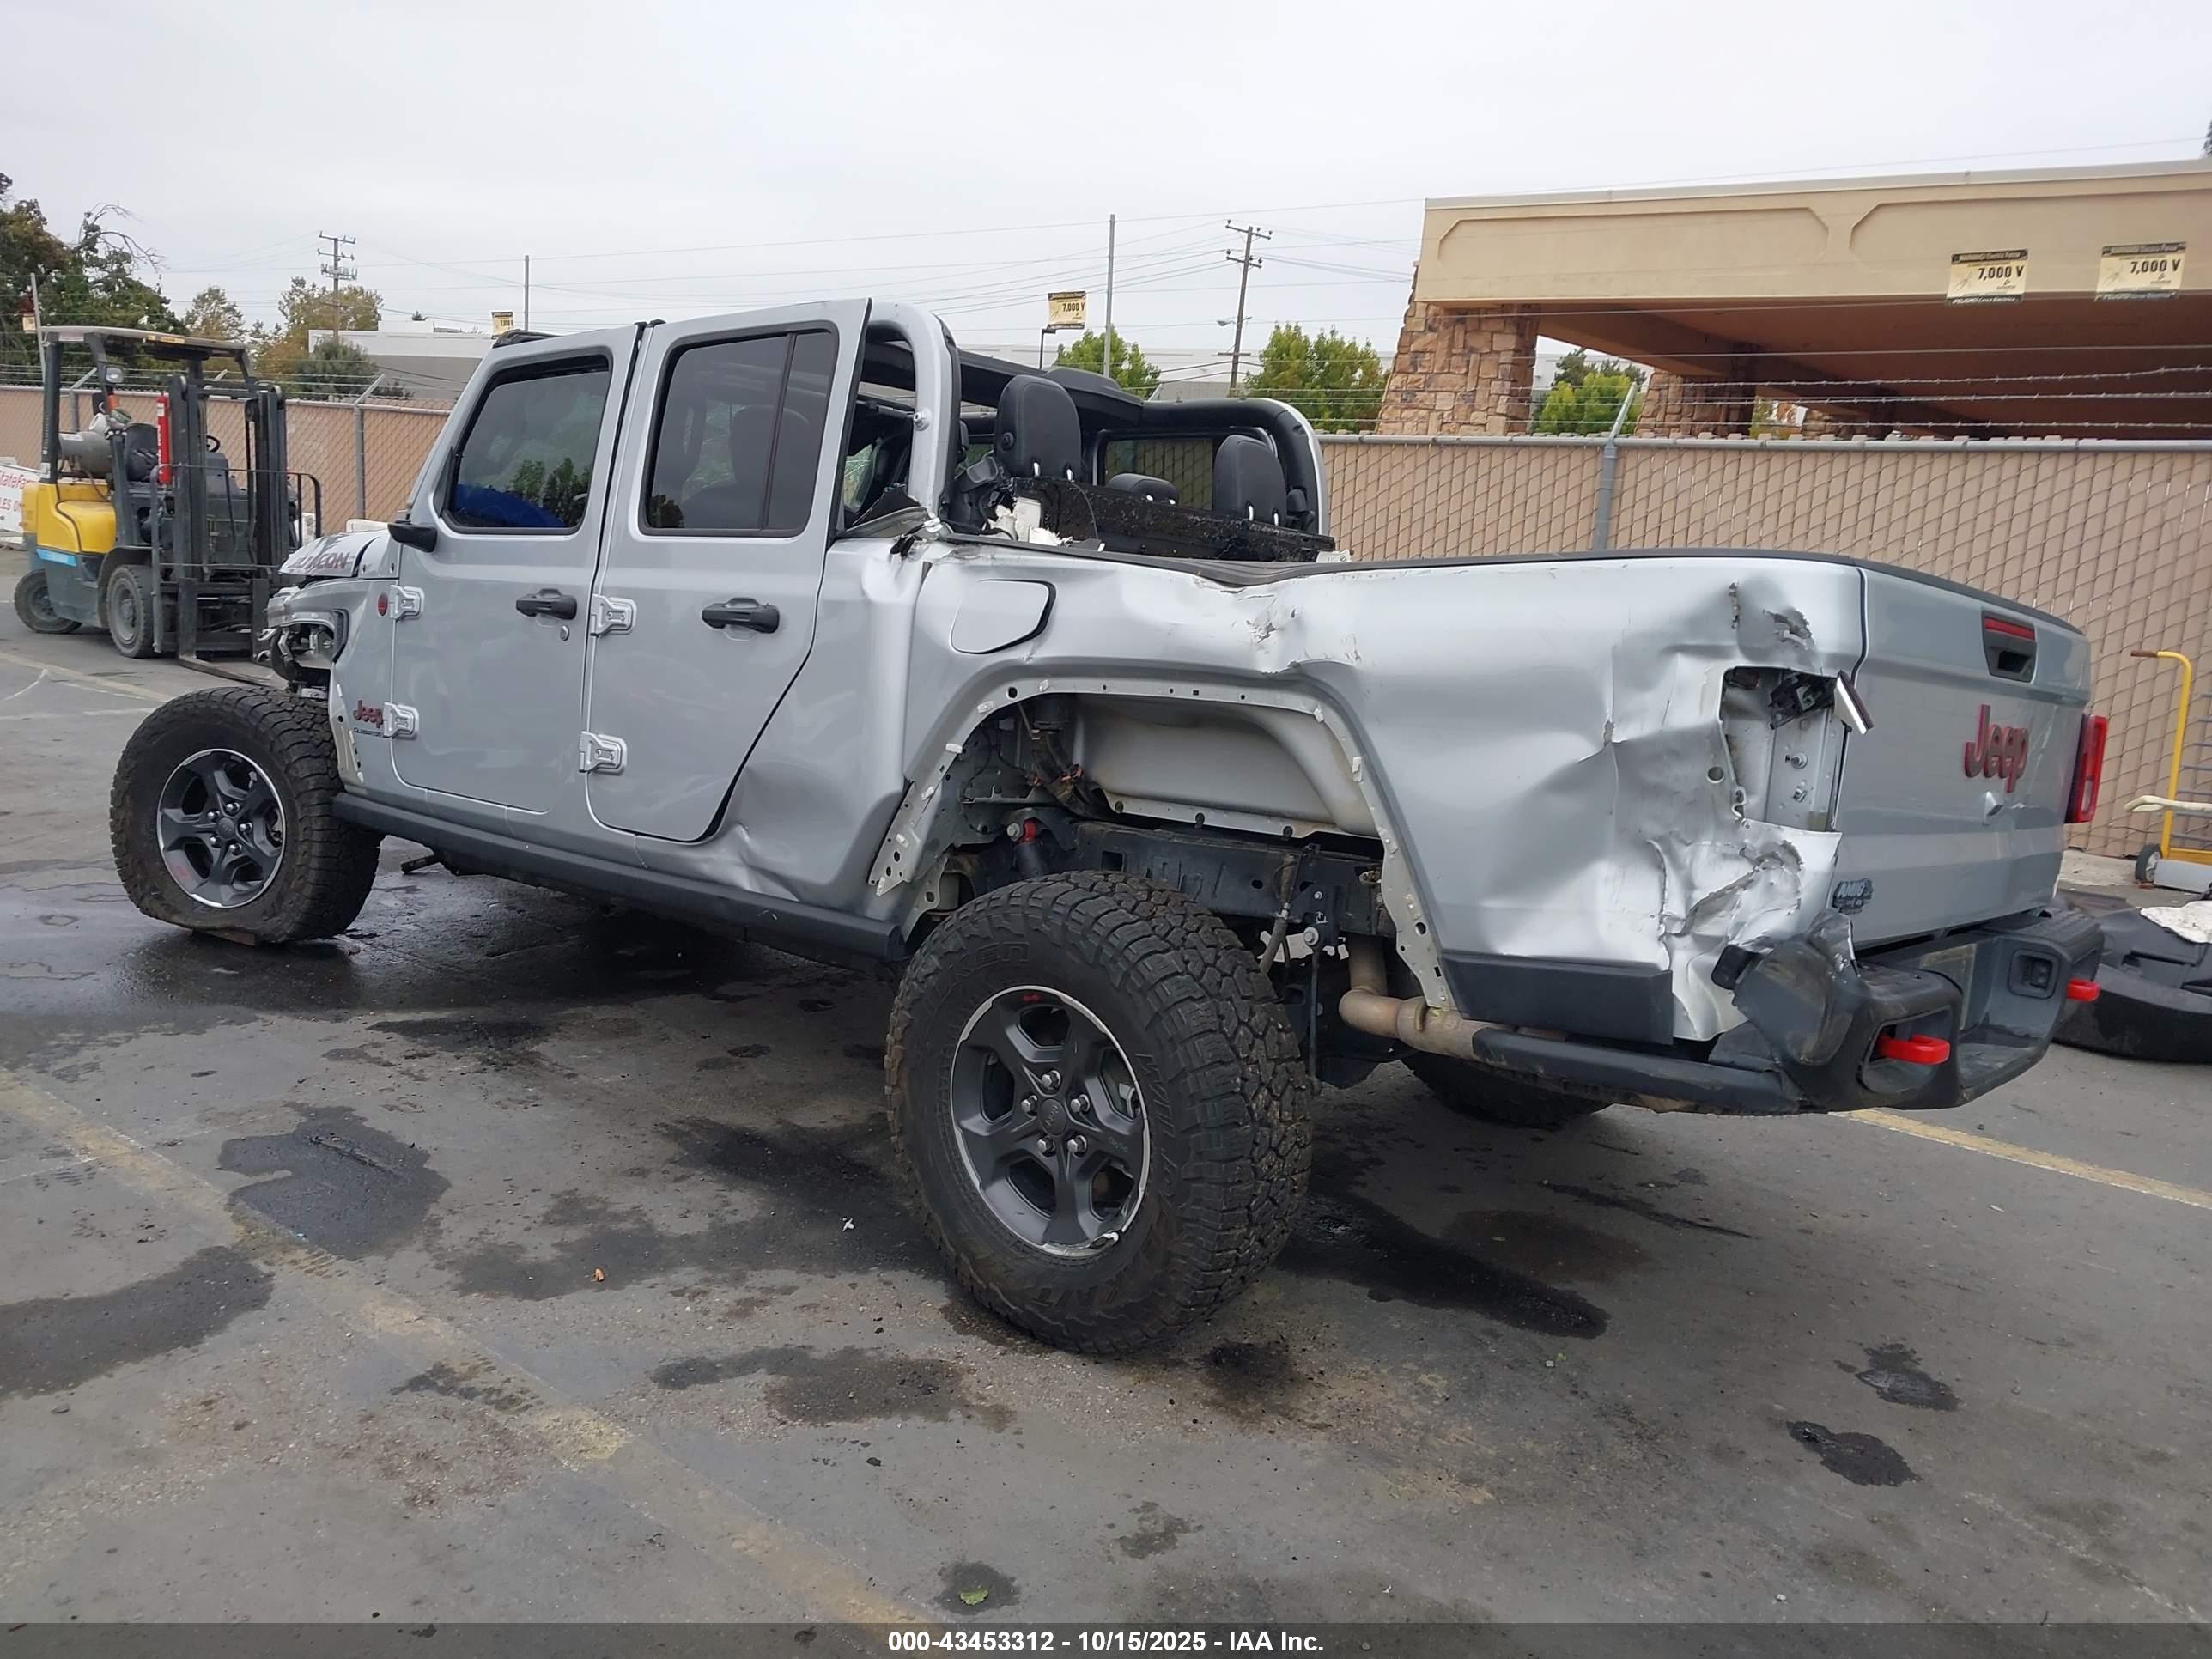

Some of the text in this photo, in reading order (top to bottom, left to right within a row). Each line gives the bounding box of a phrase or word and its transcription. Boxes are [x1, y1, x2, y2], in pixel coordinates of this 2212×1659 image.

[1978, 264, 2025, 282] 7,000 V
[2130, 258, 2181, 275] 7,000 V
[1062, 302, 1079, 312] 7,000
[353, 700, 384, 728] Jeep
[1964, 704, 2029, 793] Jeep
